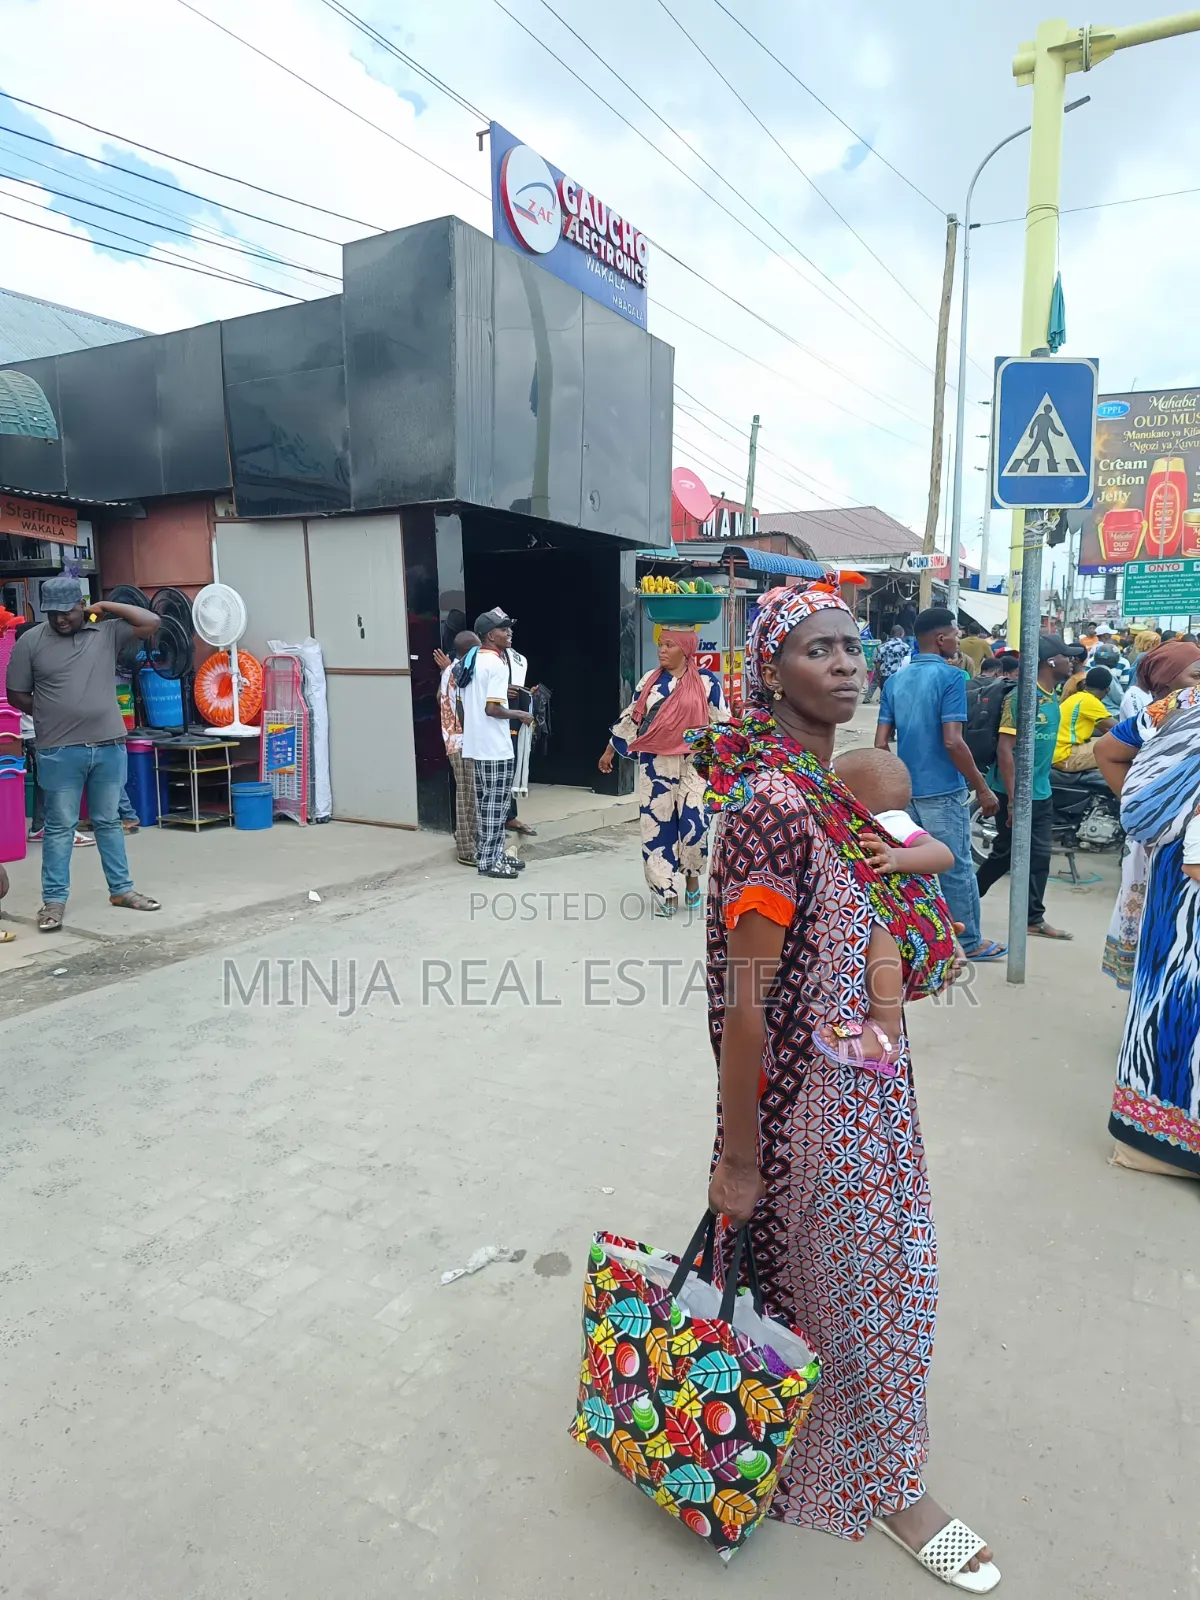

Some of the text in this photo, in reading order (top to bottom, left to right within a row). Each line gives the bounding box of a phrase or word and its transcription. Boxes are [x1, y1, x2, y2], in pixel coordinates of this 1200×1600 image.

[528, 199, 553, 226] ZAC
[560, 175, 650, 268] GAUCHO
[562, 214, 649, 289] ELECTRONICS
[585, 254, 627, 293] WAKALA
[1148, 393, 1197, 412] Mahaba
[1133, 414, 1169, 428] OUD
[1123, 430, 1170, 443] Manukato
[1171, 430, 1181, 440] ya
[1129, 440, 1159, 455] Ngozi
[1160, 442, 1172, 452] ya
[1099, 458, 1148, 471] Cream
[1097, 475, 1145, 487] Lotion
[1097, 490, 1131, 503] Jelly
[6, 501, 77, 528] StarTimes
[22, 521, 65, 536] WAKALA
[930, 555, 945, 567] SIMU
[1148, 563, 1181, 573] ONYO
[698, 639, 718, 651] ixx
